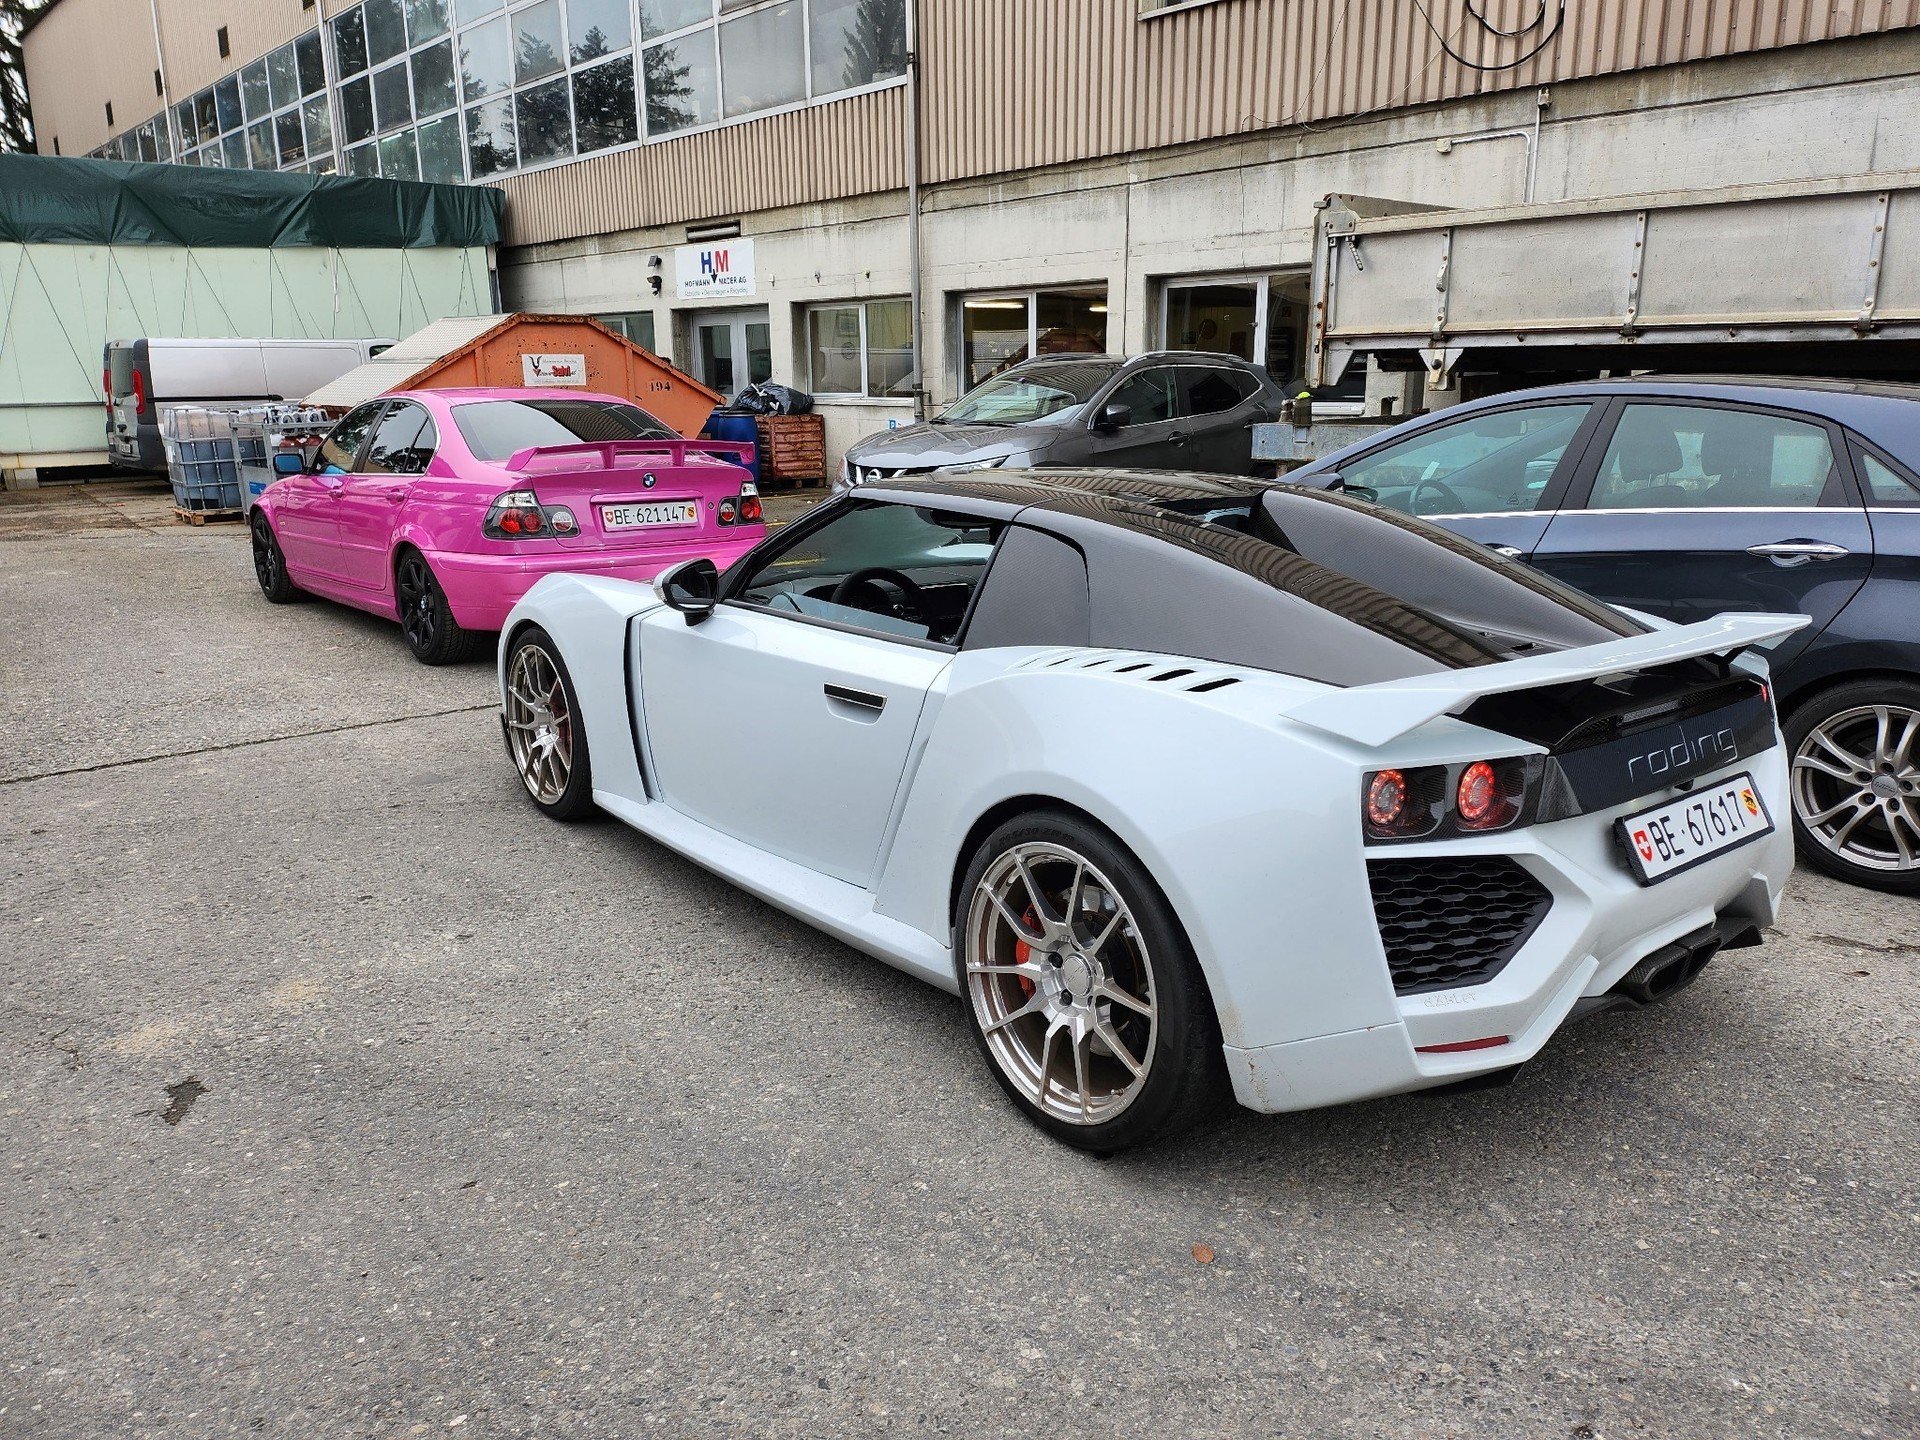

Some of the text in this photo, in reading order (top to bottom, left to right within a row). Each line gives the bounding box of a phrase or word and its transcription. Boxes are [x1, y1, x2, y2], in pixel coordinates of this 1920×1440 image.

[684, 279, 711, 288] HOFMANN
[738, 275, 747, 284] AG
[649, 380, 672, 392] 194
[1628, 725, 1739, 783] roding
